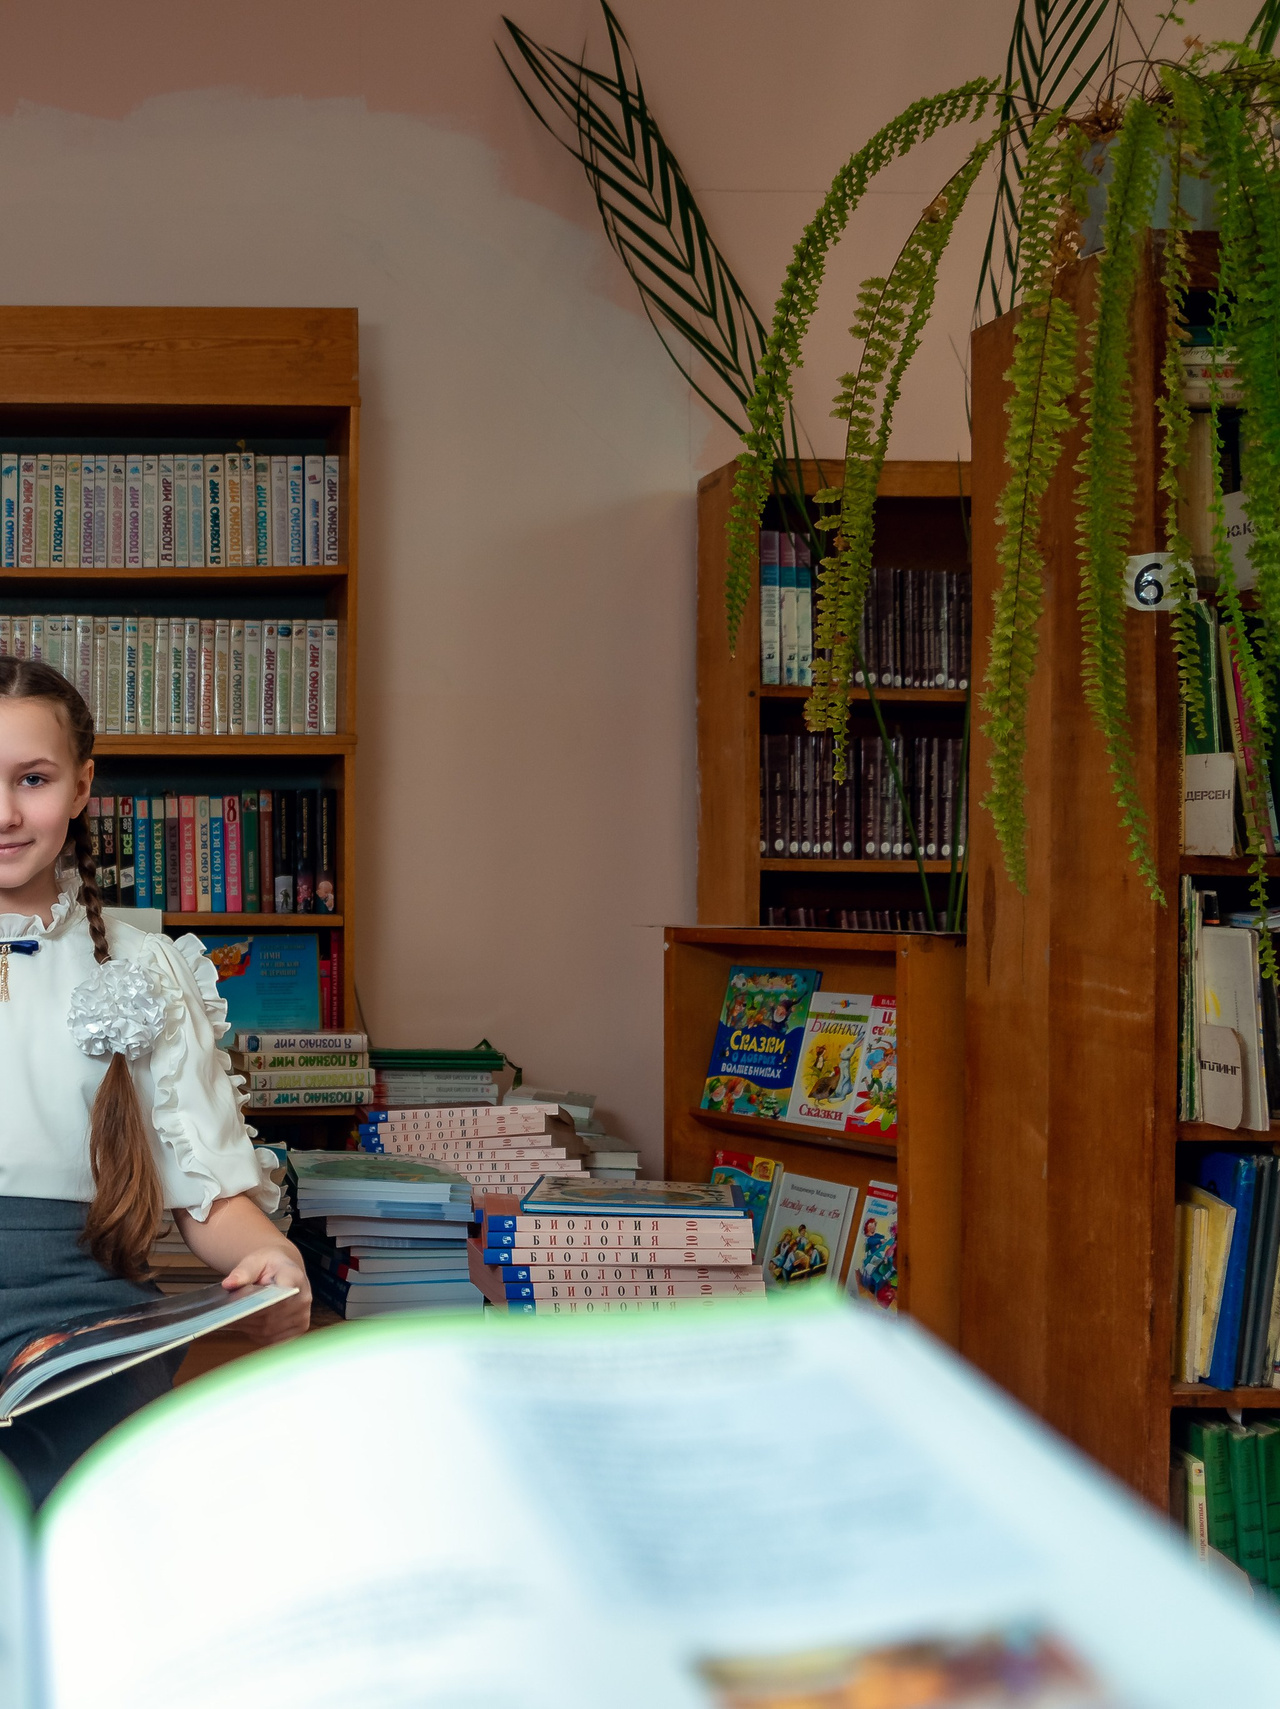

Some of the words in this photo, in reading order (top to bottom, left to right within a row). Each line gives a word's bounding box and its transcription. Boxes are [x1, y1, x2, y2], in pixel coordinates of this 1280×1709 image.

[55, 485, 63, 506] МИР
[162, 478, 172, 501] МИР
[327, 479, 337, 502] МИР
[130, 487, 139, 508] МИР
[54, 509, 63, 552] ПОЗНАЮ
[130, 511, 139, 553] ПОЗНАЮ
[162, 506, 172, 551] ПОЗНАЮ
[327, 505, 337, 550] ПОЗНАЮ
[53, 554, 62, 562] Я
[129, 556, 139, 564] Я
[326, 553, 337, 561] Я
[1134, 562, 1164, 605] 6
[310, 644, 319, 667] МИР
[308, 672, 319, 717] ПОЗНАЮ
[307, 719, 317, 728] Я
[1185, 790, 1230, 801] ДЕРСЕН
[199, 800, 207, 817] 6
[227, 798, 236, 821] 8
[810, 1013, 864, 1036] Бианки
[274, 1039, 296, 1048] МИР
[300, 1039, 341, 1048] ПОЗНАЮ
[345, 1039, 351, 1048] Я
[269, 1056, 294, 1067] МИР
[299, 1055, 346, 1066] ПОЗНАЮ
[349, 1054, 358, 1067] Я
[274, 1093, 300, 1104] МИР
[304, 1093, 352, 1103] ПОЗНАЮ
[355, 1093, 364, 1104] Я
[401, 1108, 490, 1120] БИОЛОГИЯ
[799, 1104, 843, 1120] Сказки
[390, 1118, 478, 1131] БИОЛОГИЯ
[497, 1116, 505, 1124] 10
[393, 1129, 478, 1142] БИОЛОГИЯ
[498, 1126, 506, 1134] 10
[396, 1141, 484, 1153] БИОЛОГИЯ
[503, 1139, 512, 1147] 10
[516, 1150, 525, 1158] 10
[530, 1162, 539, 1170] 10
[534, 1220, 659, 1231] БИОЛОГИЯ
[686, 1221, 698, 1231] 10
[533, 1236, 659, 1246] БИОЛОГИЯ
[686, 1236, 698, 1246] 10
[530, 1252, 657, 1262] БИОЛОГИЯ
[684, 1252, 696, 1262] 10
[549, 1269, 671, 1280] БИОЛОГИЯ
[697, 1268, 709, 1279] 10
[552, 1286, 674, 1297] БИОЛОГИЯ
[700, 1285, 712, 1295] 10
